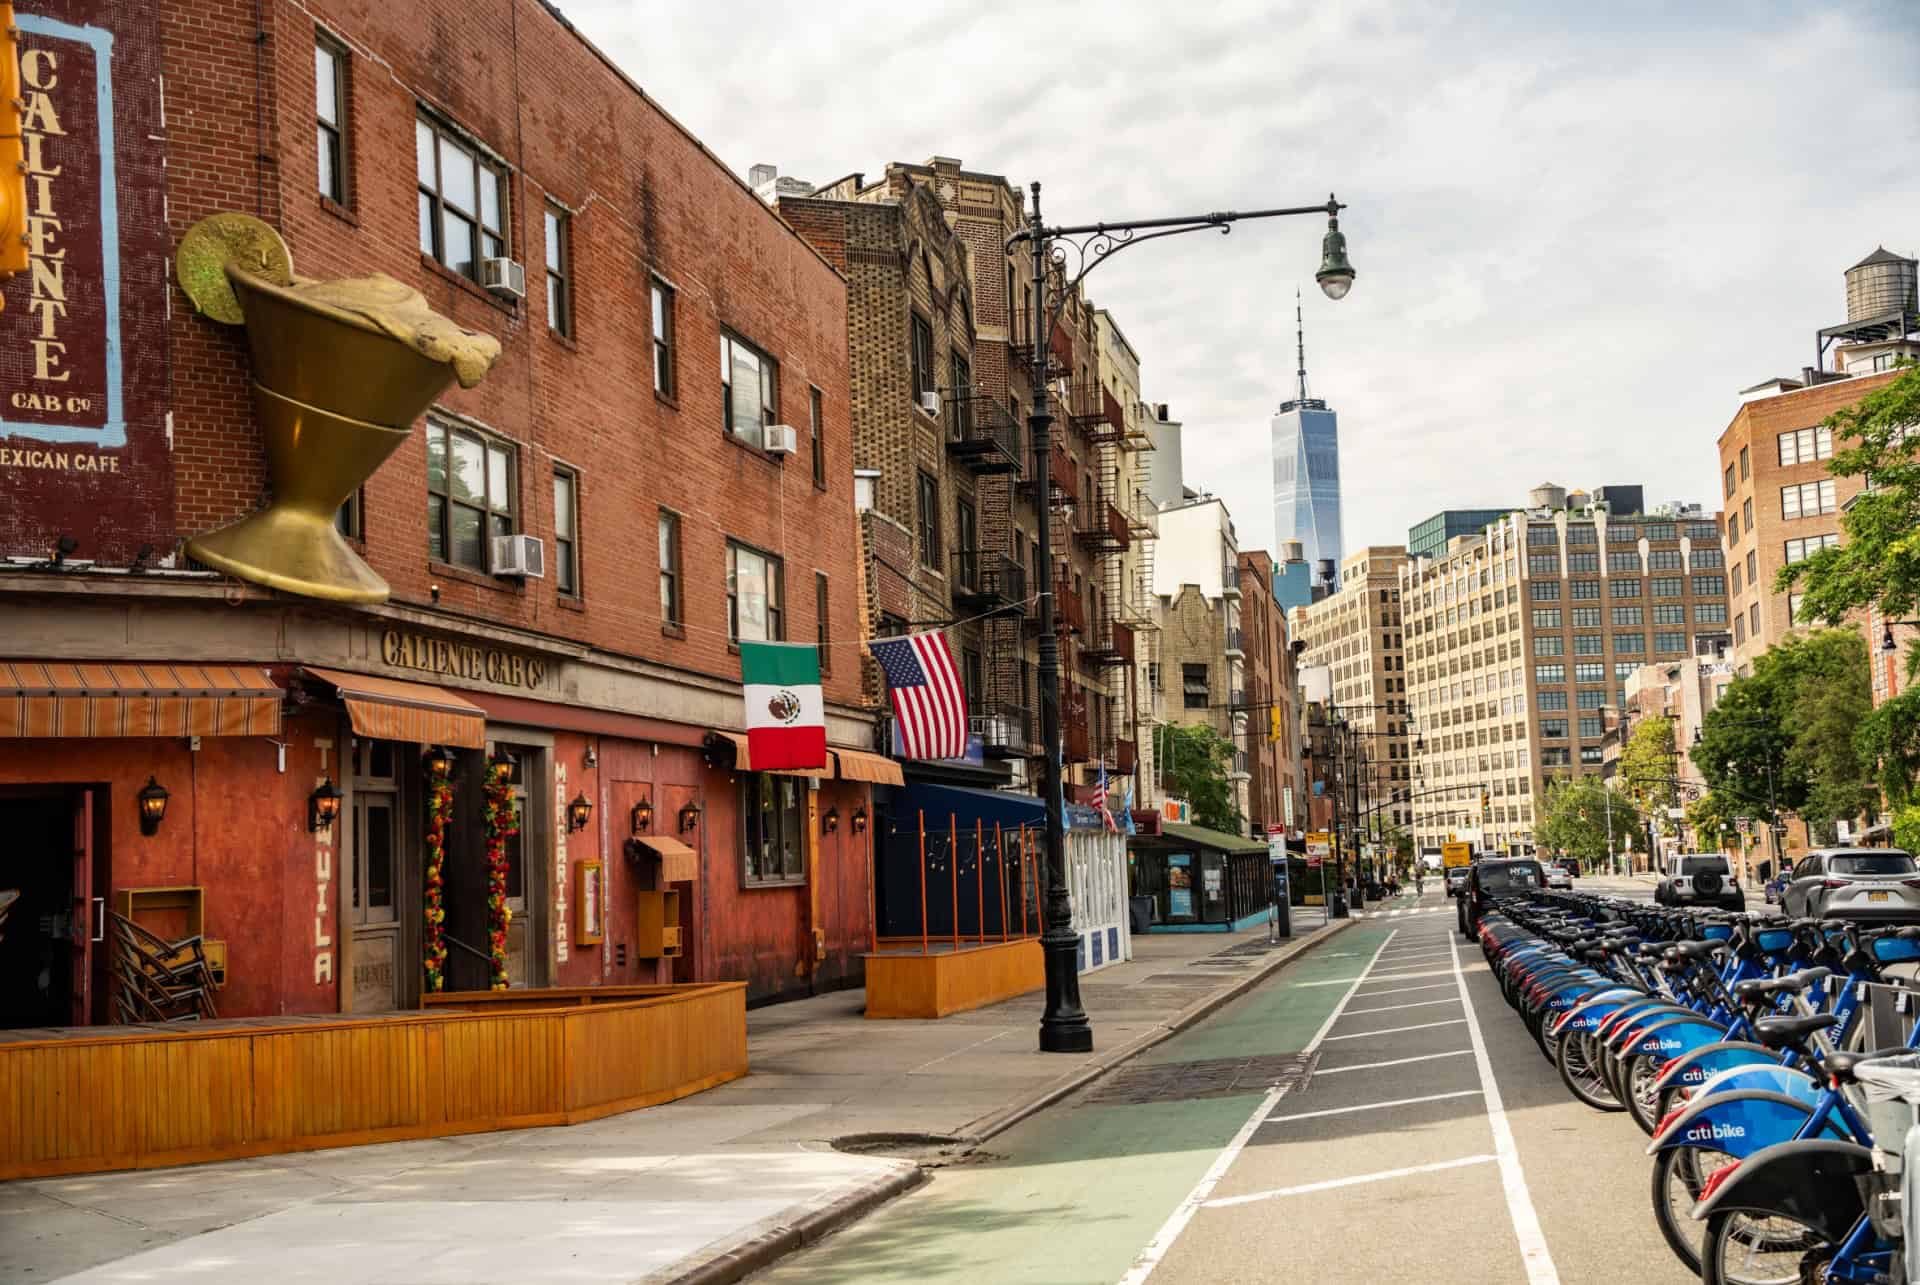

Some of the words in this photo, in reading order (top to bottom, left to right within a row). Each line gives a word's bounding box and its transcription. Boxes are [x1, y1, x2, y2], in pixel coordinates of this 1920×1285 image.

[21, 50, 70, 381] CALIENTE
[12, 393, 62, 412] CAB
[0, 448, 68, 470] EXICAN
[74, 453, 120, 473] CAFE
[382, 630, 481, 680] CALIENTE
[314, 738, 333, 985] TUILA
[555, 762, 568, 963] MARGARITAS
[1572, 1019, 1586, 1027] citi
[1643, 1041, 1659, 1051] citi
[1660, 1039, 1681, 1049] bike
[1683, 1071, 1702, 1081] citi
[1687, 1126, 1711, 1141] citi
[1712, 1124, 1745, 1139] bike
